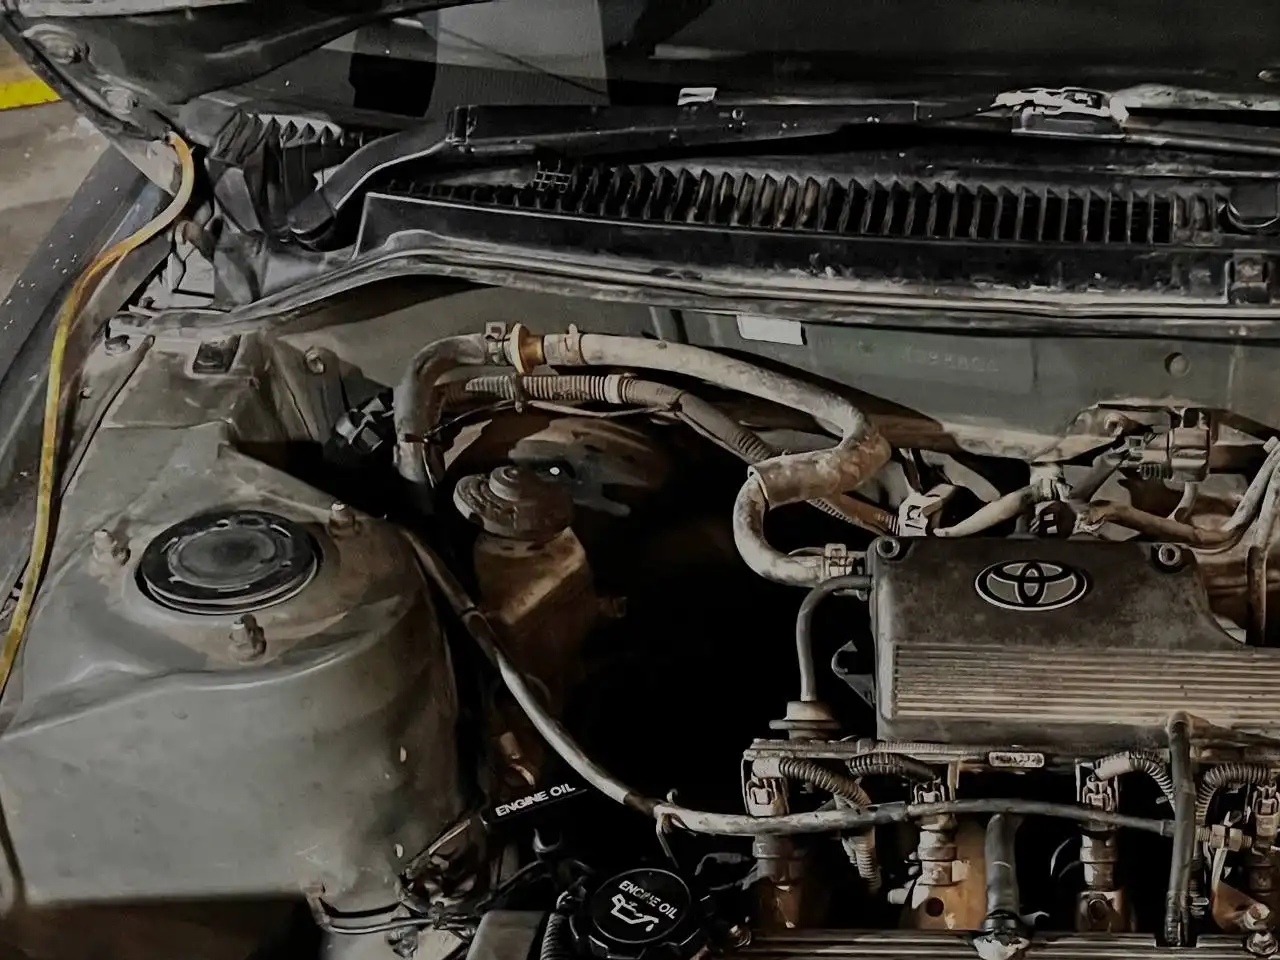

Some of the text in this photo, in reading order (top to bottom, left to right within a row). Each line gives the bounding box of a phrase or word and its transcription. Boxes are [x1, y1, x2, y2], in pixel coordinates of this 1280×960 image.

[495, 783, 576, 817] ENGINE OIL
[658, 902, 678, 920] OIL
